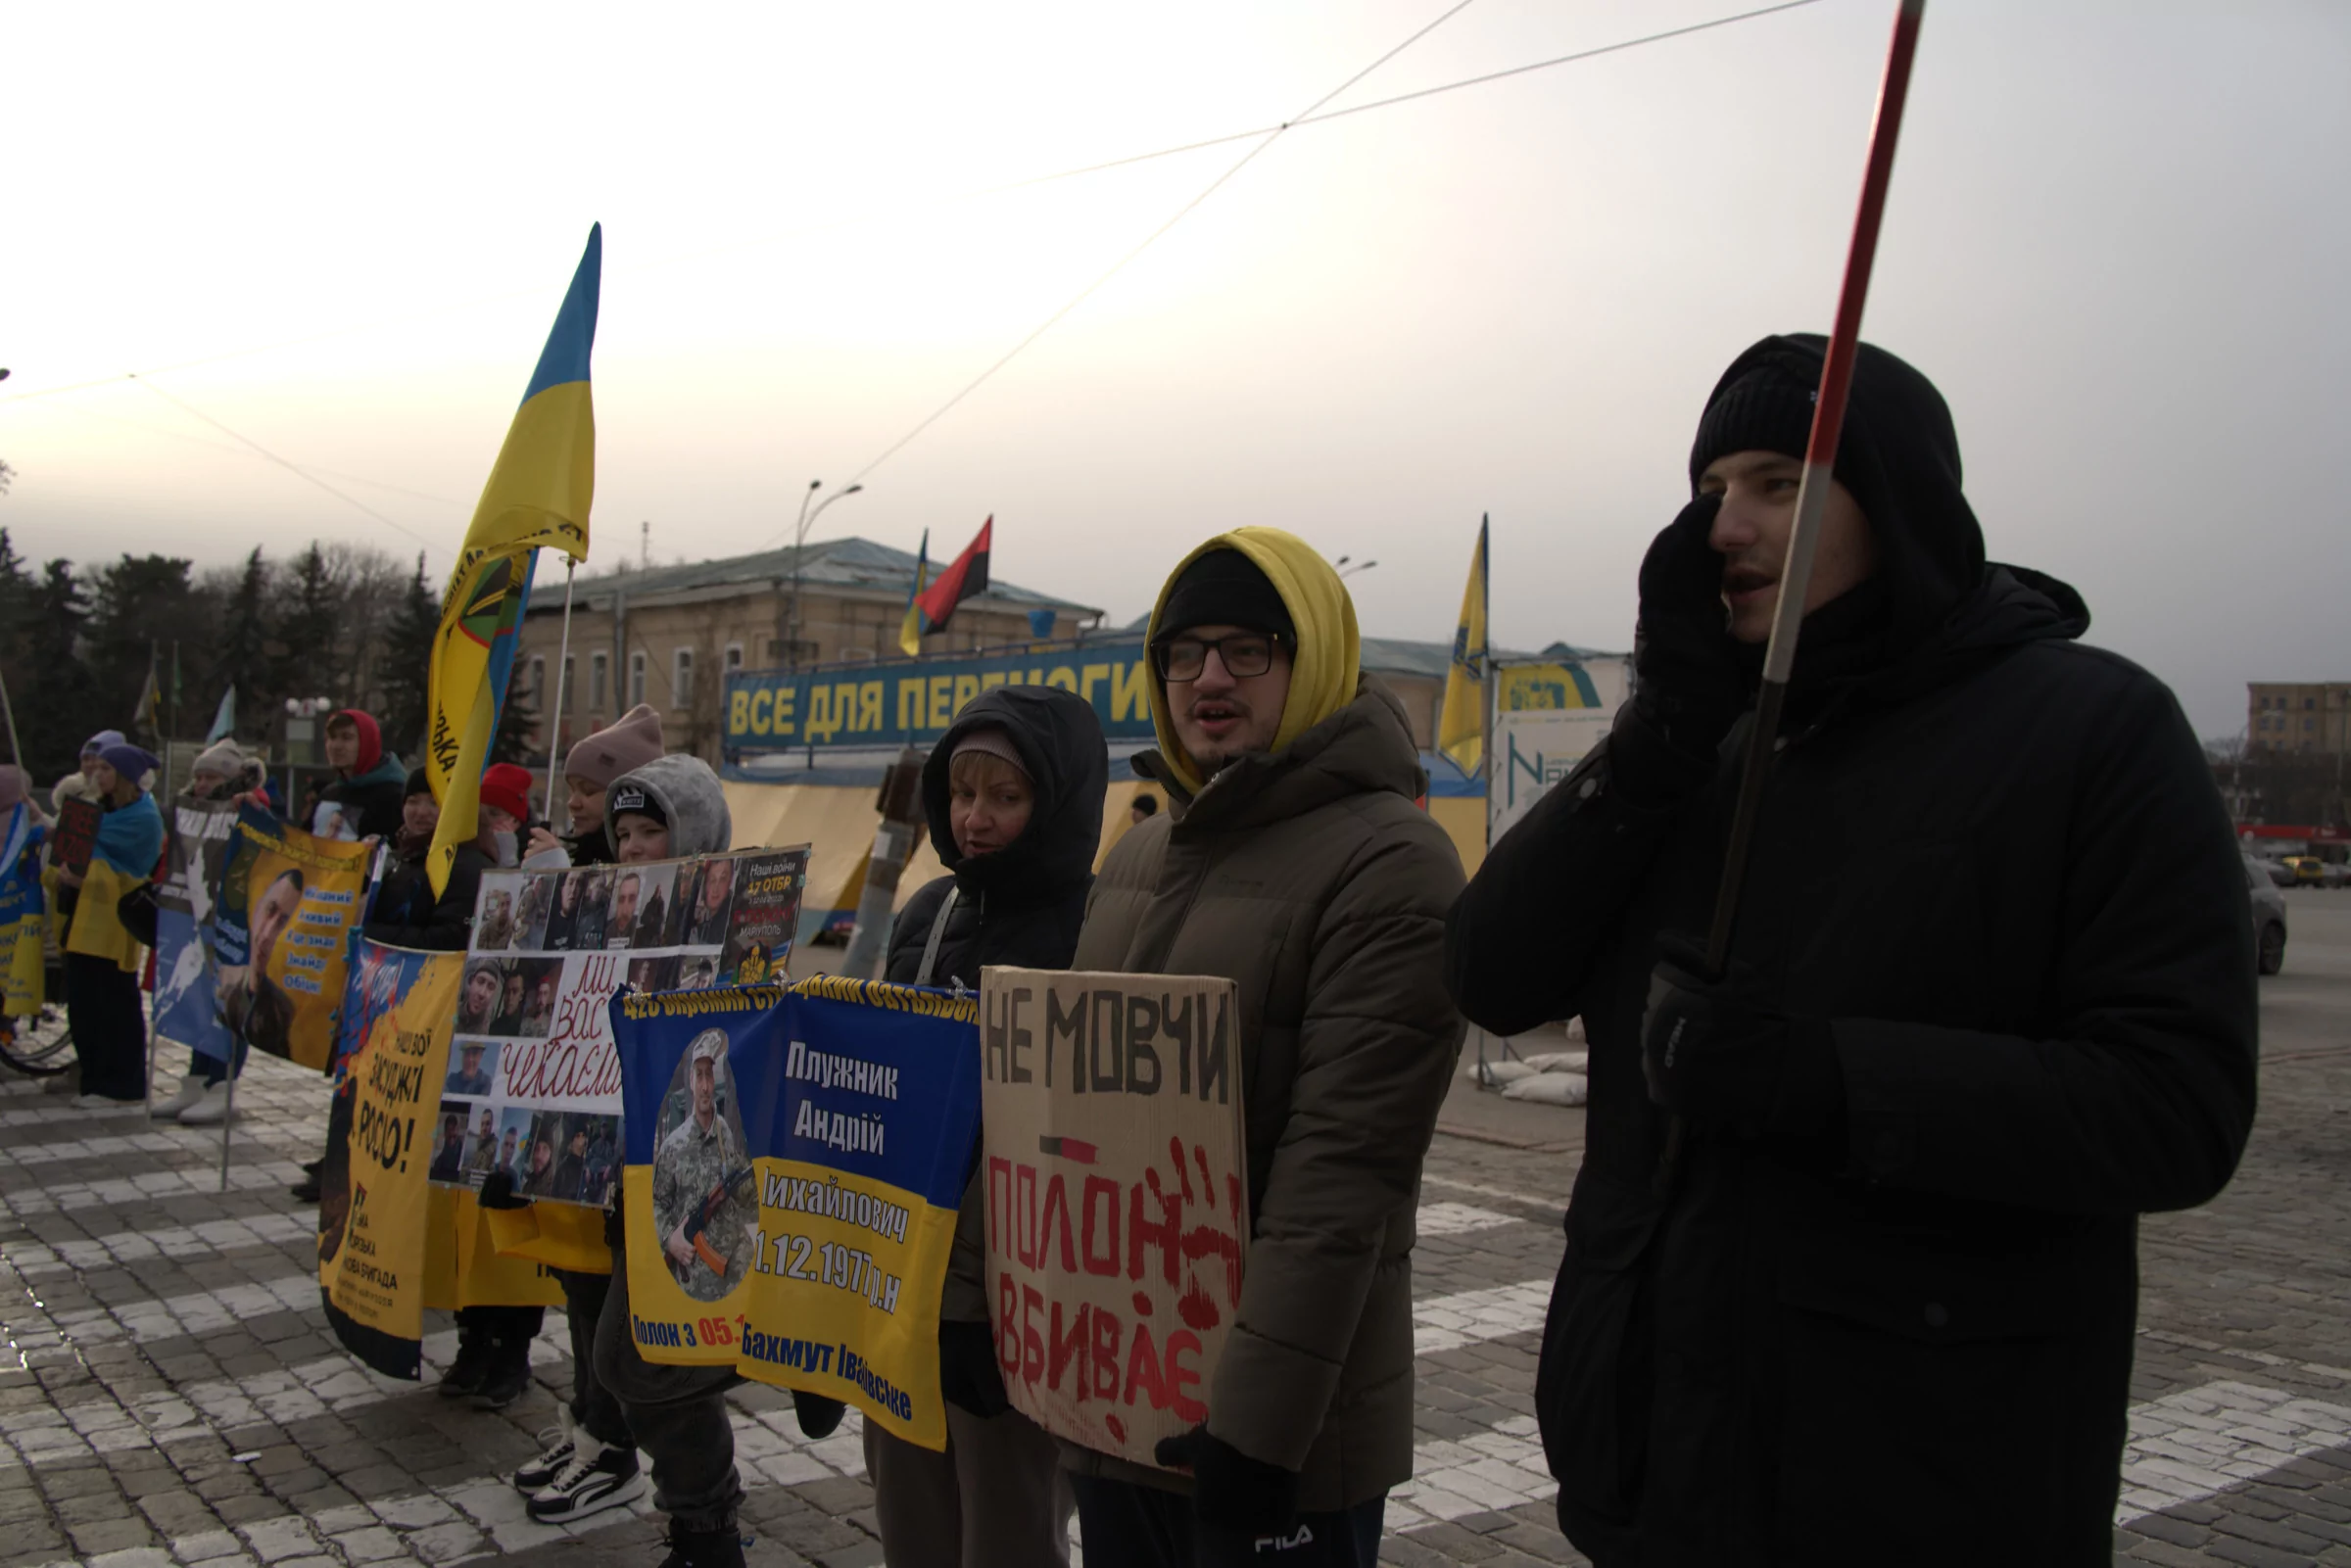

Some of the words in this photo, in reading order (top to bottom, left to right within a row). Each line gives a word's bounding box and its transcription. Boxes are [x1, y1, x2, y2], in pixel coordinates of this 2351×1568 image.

[729, 687, 795, 736] ВСЕ
[803, 680, 885, 743] ДЛЯ
[740, 925, 781, 937] МАРІУПОЛЬ
[785, 1039, 899, 1100] Плужник
[985, 987, 1032, 1084] НЕ
[1044, 987, 1229, 1105] МОВЧИ
[1664, 1016, 1687, 1069] HEAD
[793, 1099, 886, 1156] Андрій
[762, 1165, 909, 1245] ихайлович
[988, 1155, 1181, 1288] ПОЛОН
[742, 1321, 835, 1373] Бахмут
[998, 1272, 1211, 1424] ВБИВАЄ
[1255, 1524, 1314, 1553] FILA
